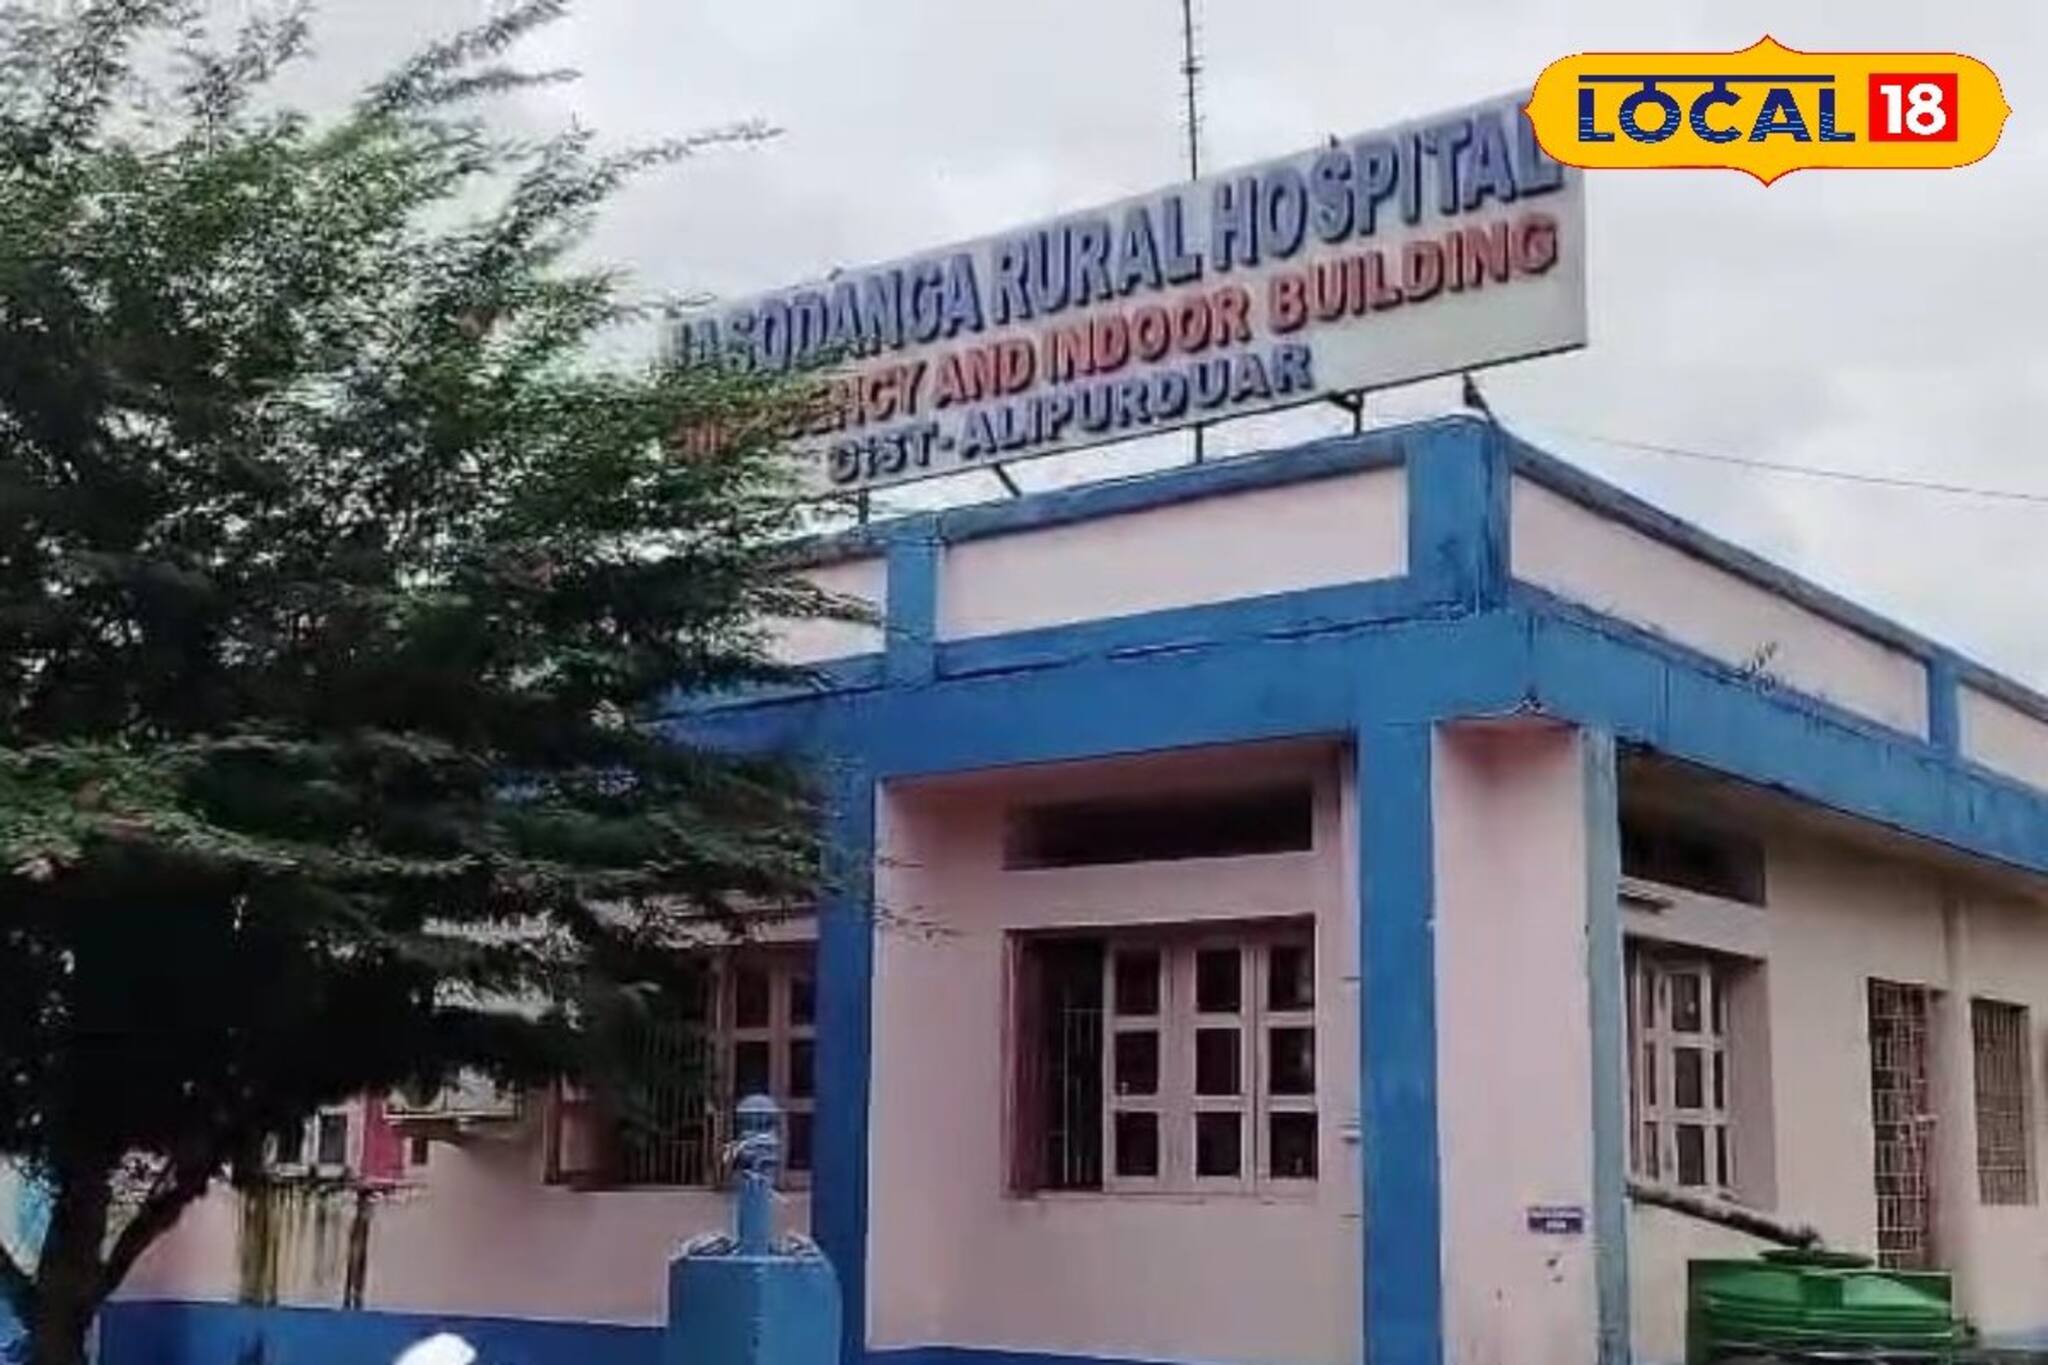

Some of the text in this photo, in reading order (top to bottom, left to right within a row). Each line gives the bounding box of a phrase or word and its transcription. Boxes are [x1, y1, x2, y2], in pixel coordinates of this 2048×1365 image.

[935, 335, 1037, 409] AND
[1041, 284, 1251, 386] INDOOR
[1269, 213, 1558, 334] BUILDING
[995, 192, 1201, 325] RURAL
[1207, 96, 1564, 273] HOSPITAL
